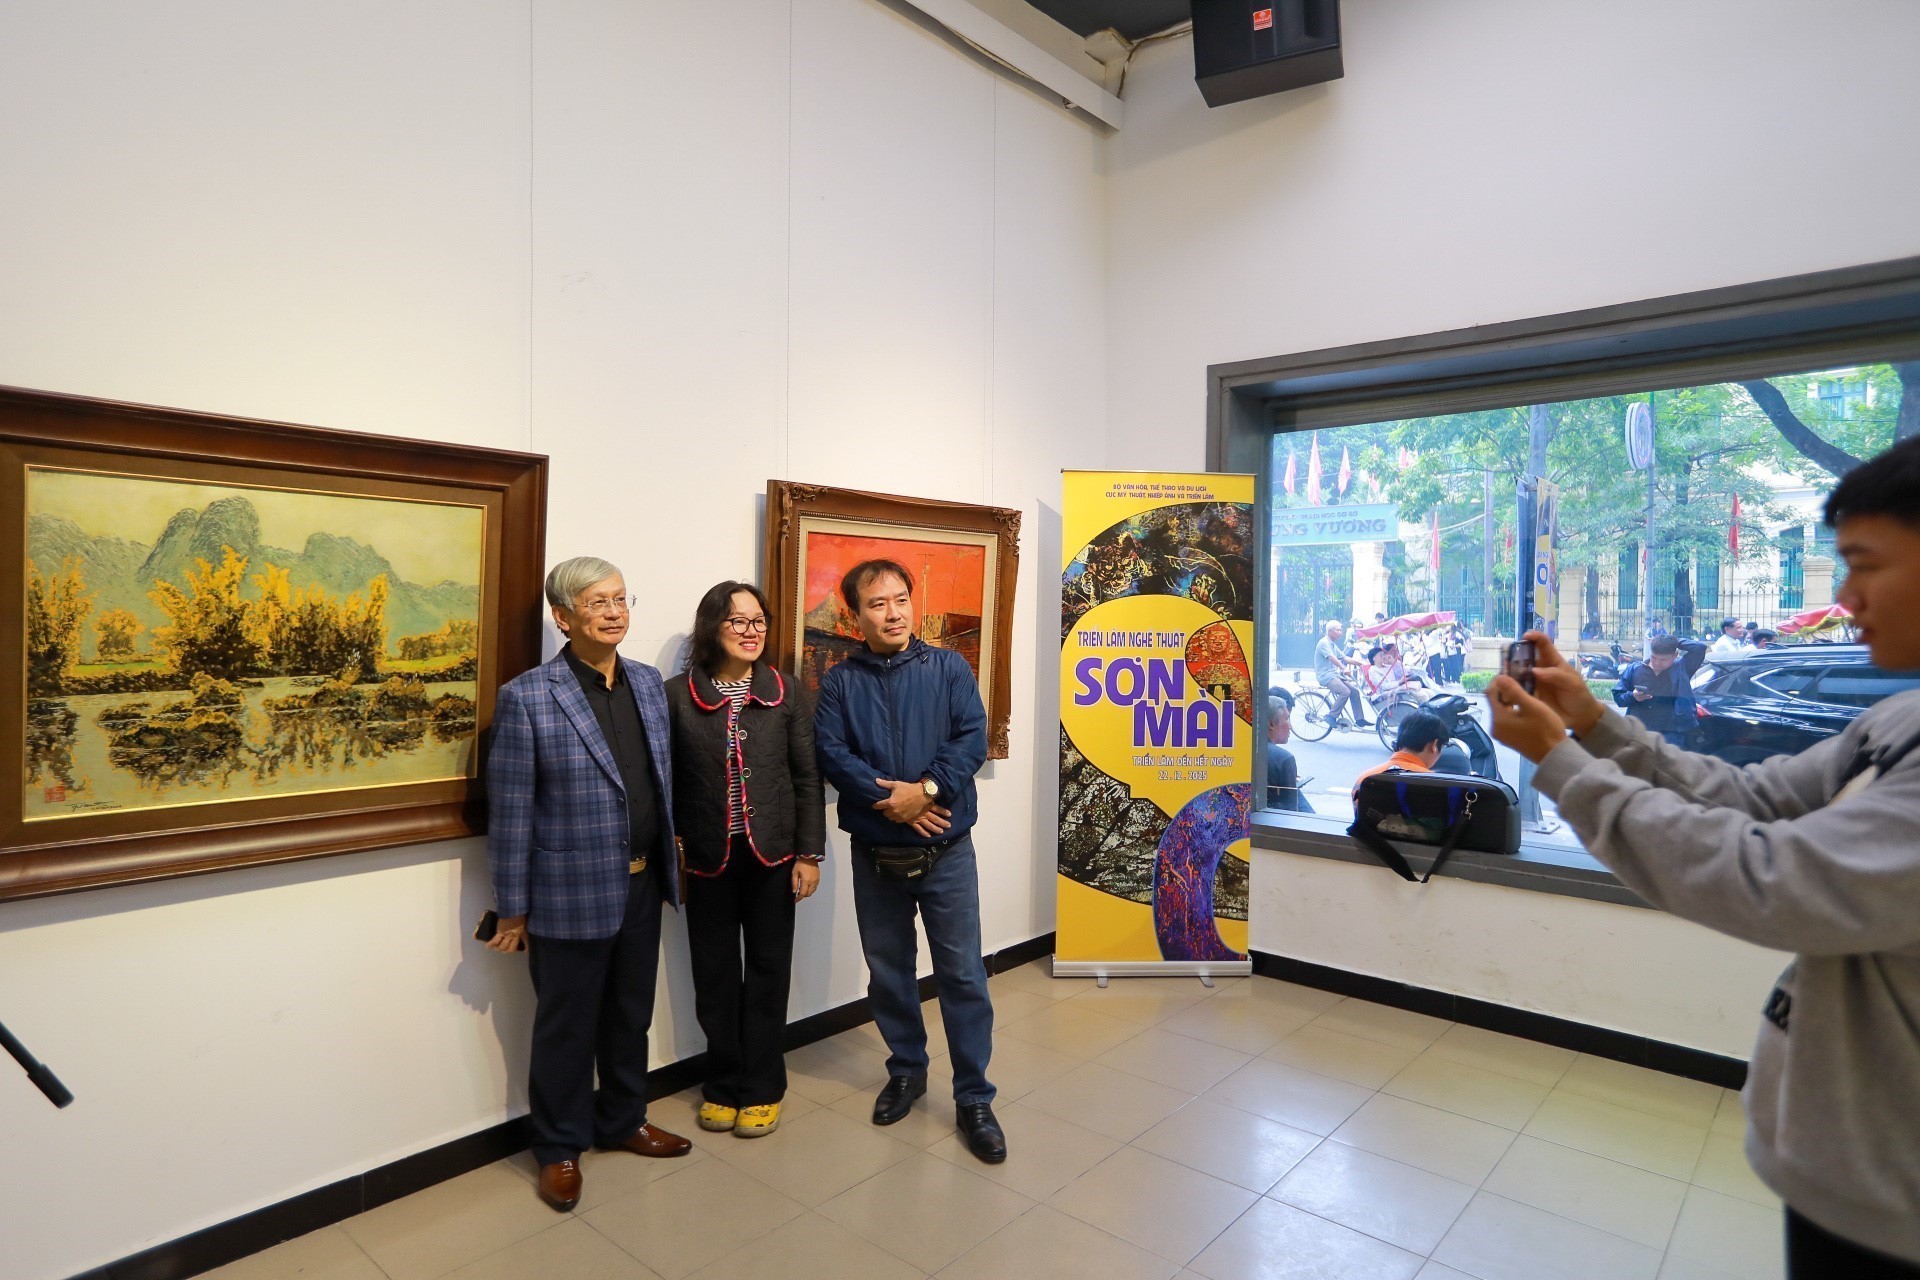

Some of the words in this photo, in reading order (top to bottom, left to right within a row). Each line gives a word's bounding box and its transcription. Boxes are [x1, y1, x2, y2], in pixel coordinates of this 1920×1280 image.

[1314, 518, 1387, 535] VƯƠNG
[1074, 656, 1185, 706] SƠN
[1133, 689, 1235, 748] MÀI
